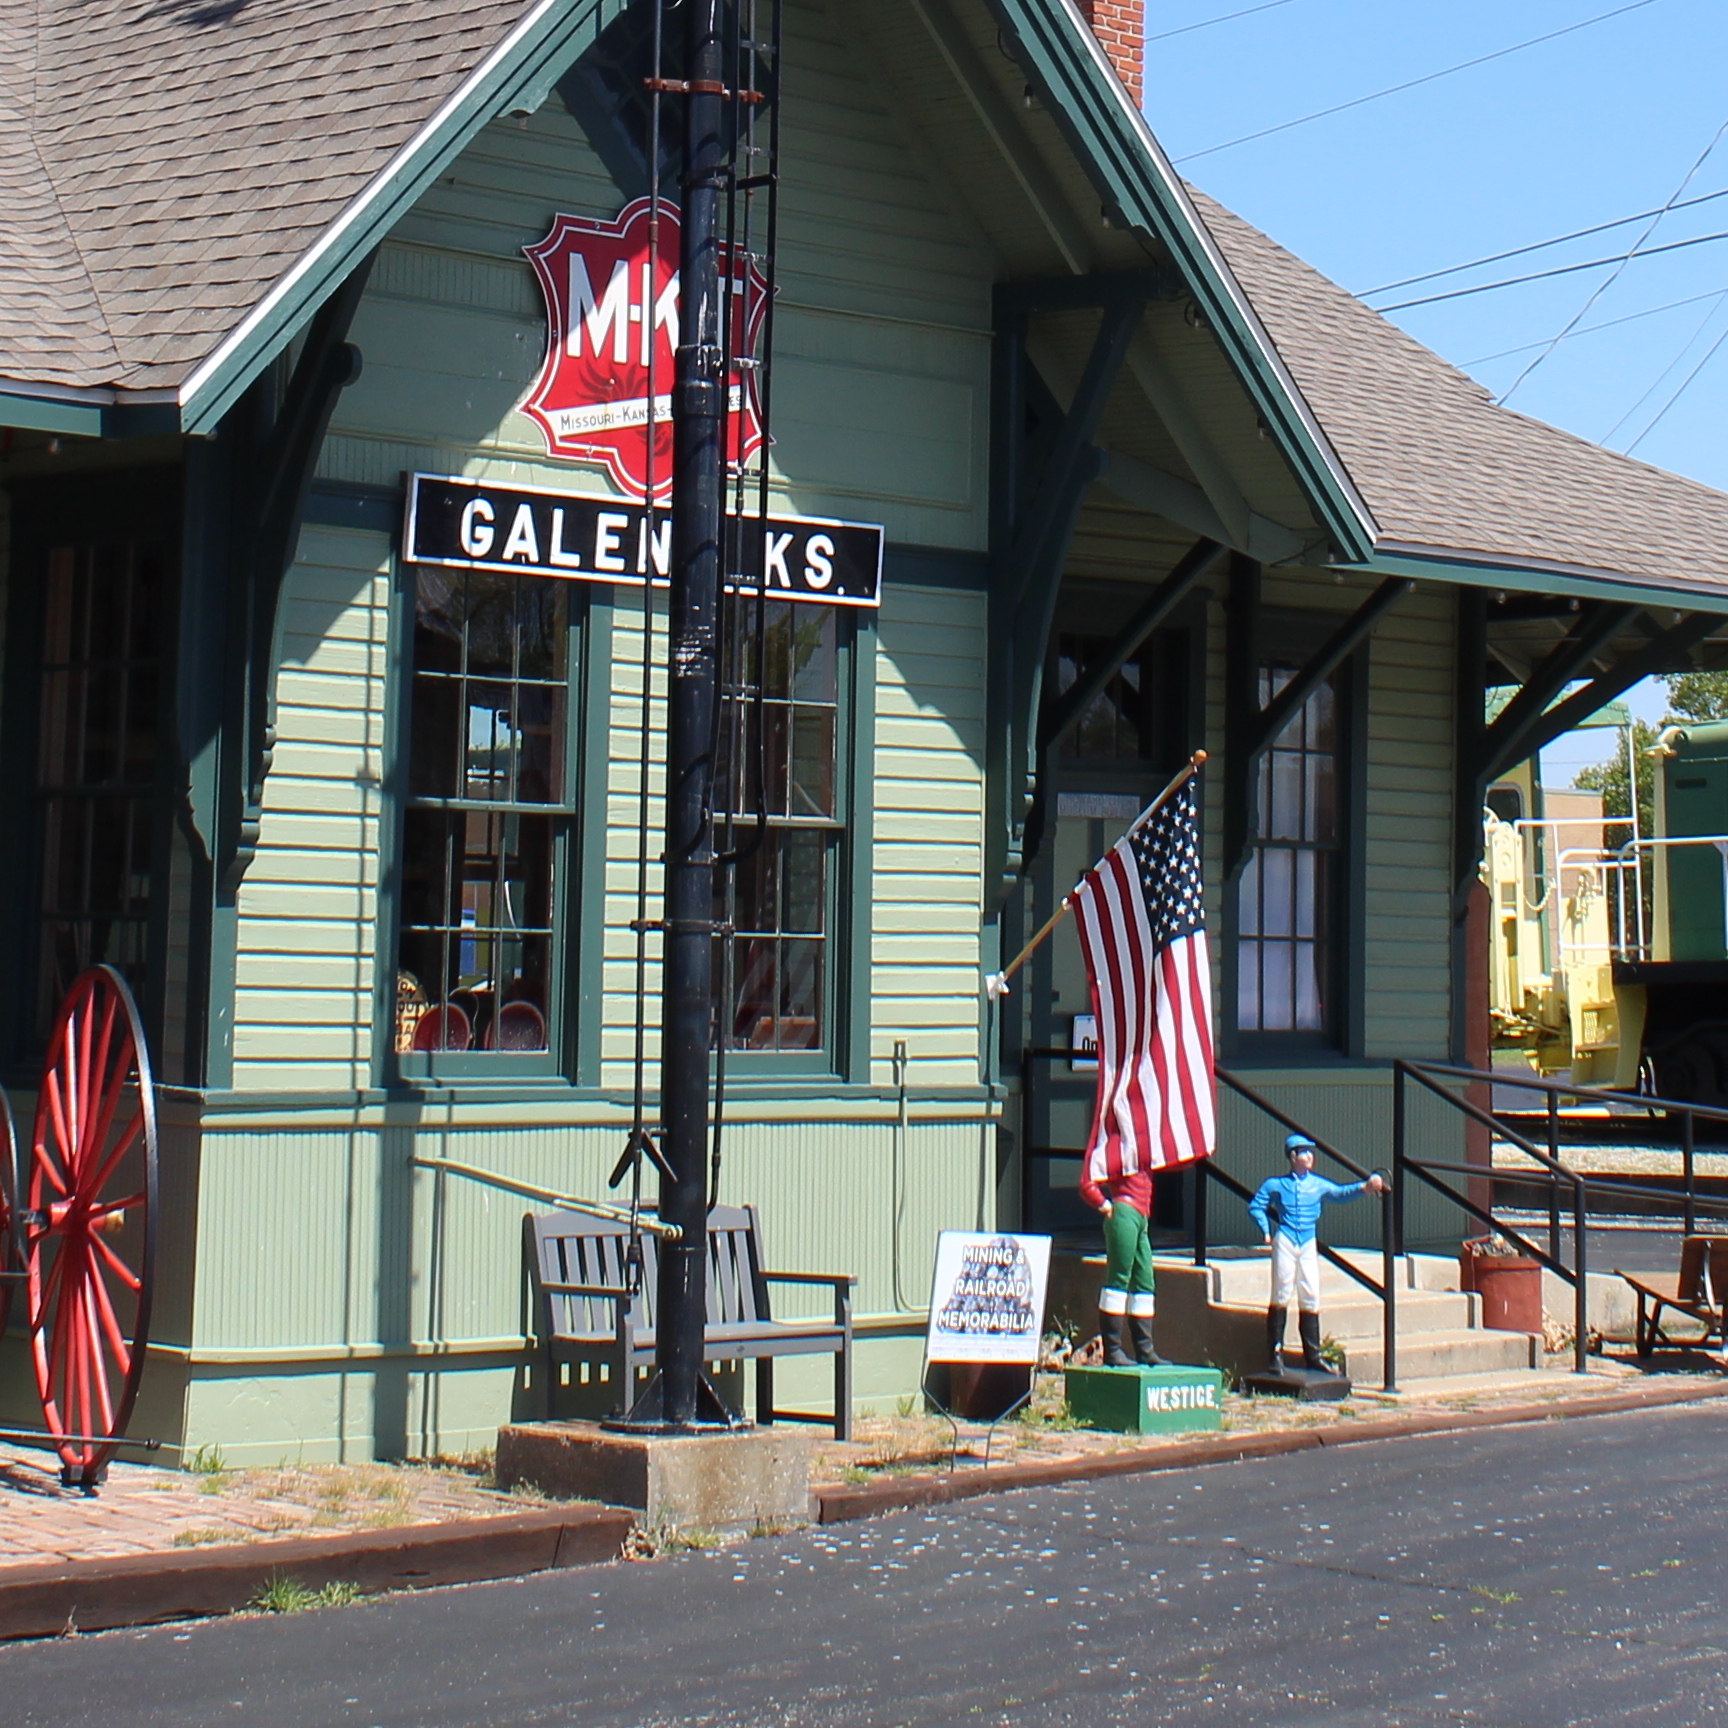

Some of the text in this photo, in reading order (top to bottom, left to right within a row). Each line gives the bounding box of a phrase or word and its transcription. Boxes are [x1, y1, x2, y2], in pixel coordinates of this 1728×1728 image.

[567, 252, 744, 367] M-KT
[460, 499, 845, 596] GALEN KS.
[963, 1246, 1026, 1265] MINING &
[955, 1277, 1027, 1297] RAILROAD
[937, 1310, 1034, 1329] MEMORABILIA
